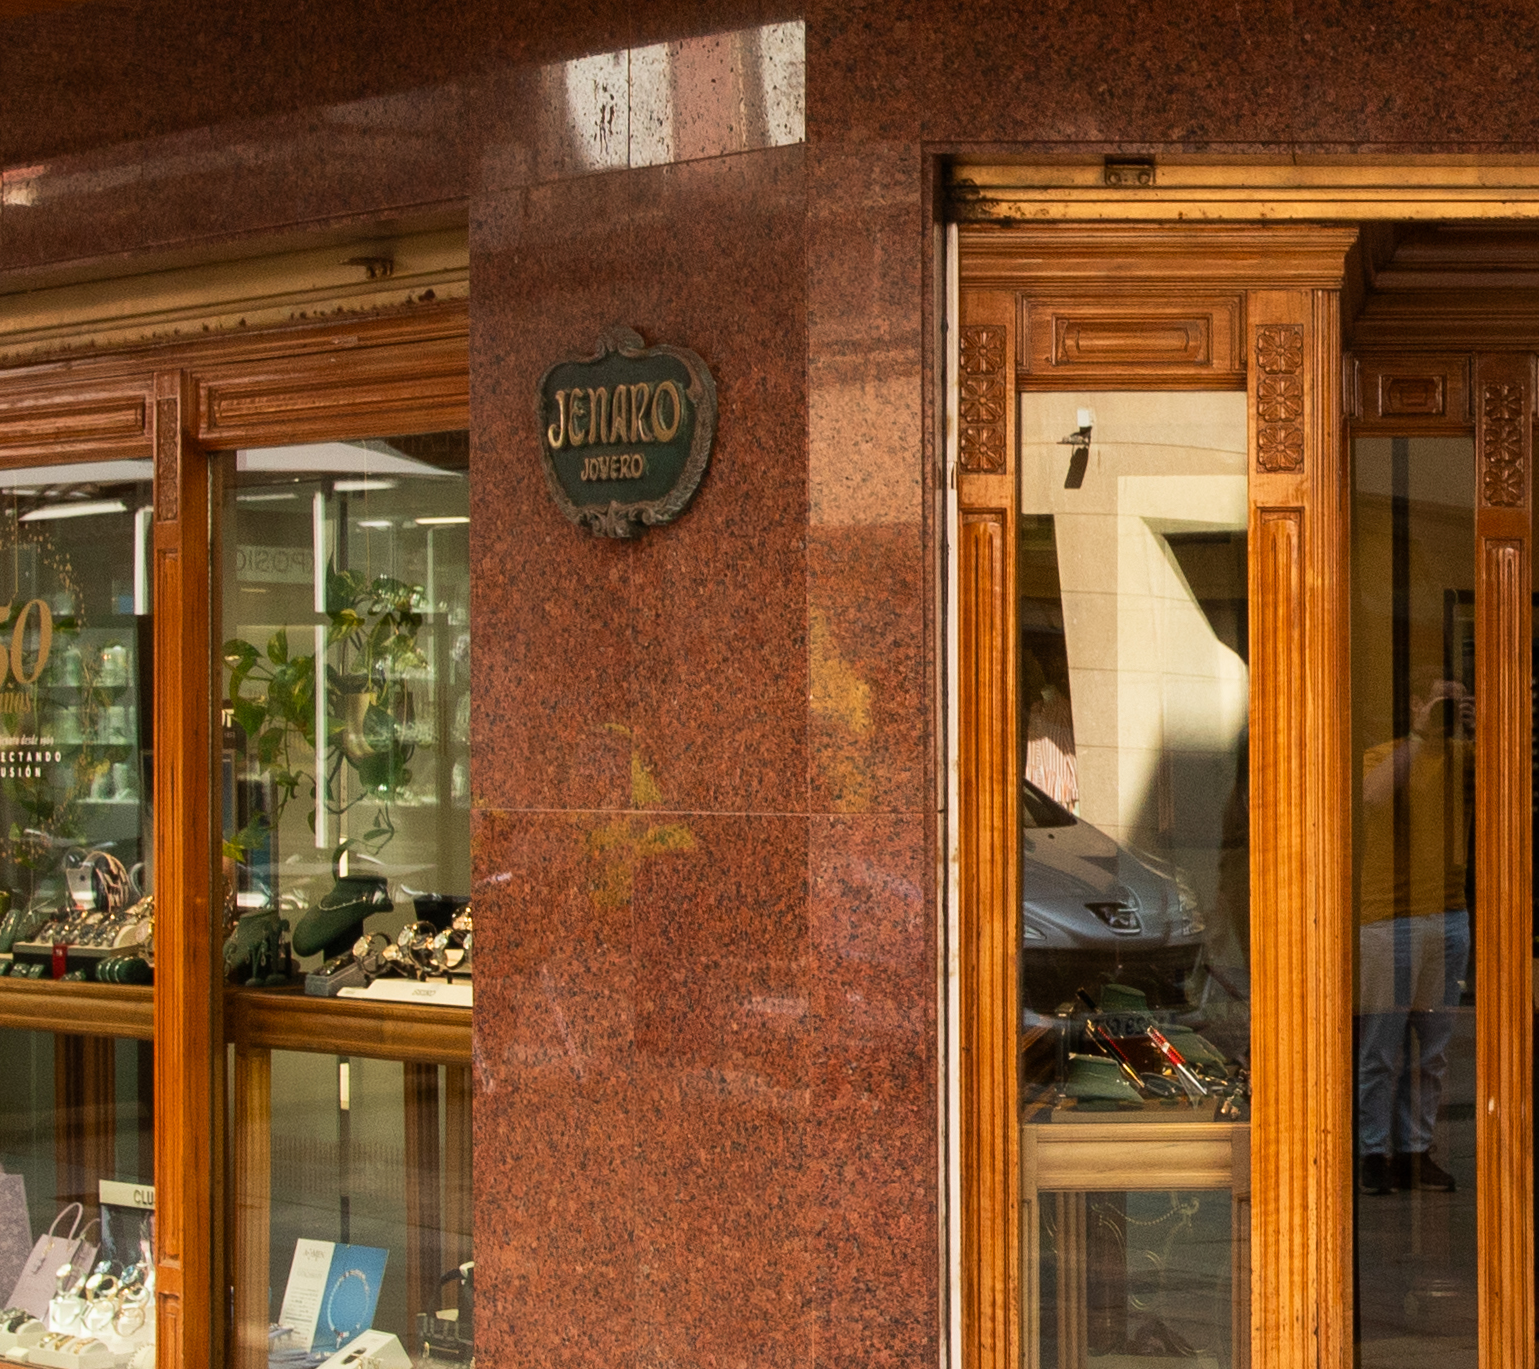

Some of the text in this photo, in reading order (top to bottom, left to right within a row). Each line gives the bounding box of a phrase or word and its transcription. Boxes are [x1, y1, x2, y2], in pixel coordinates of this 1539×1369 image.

[548, 380, 682, 450] JENARO
[580, 453, 646, 481] JOYERO
[133, 1189, 156, 1206] CLU
